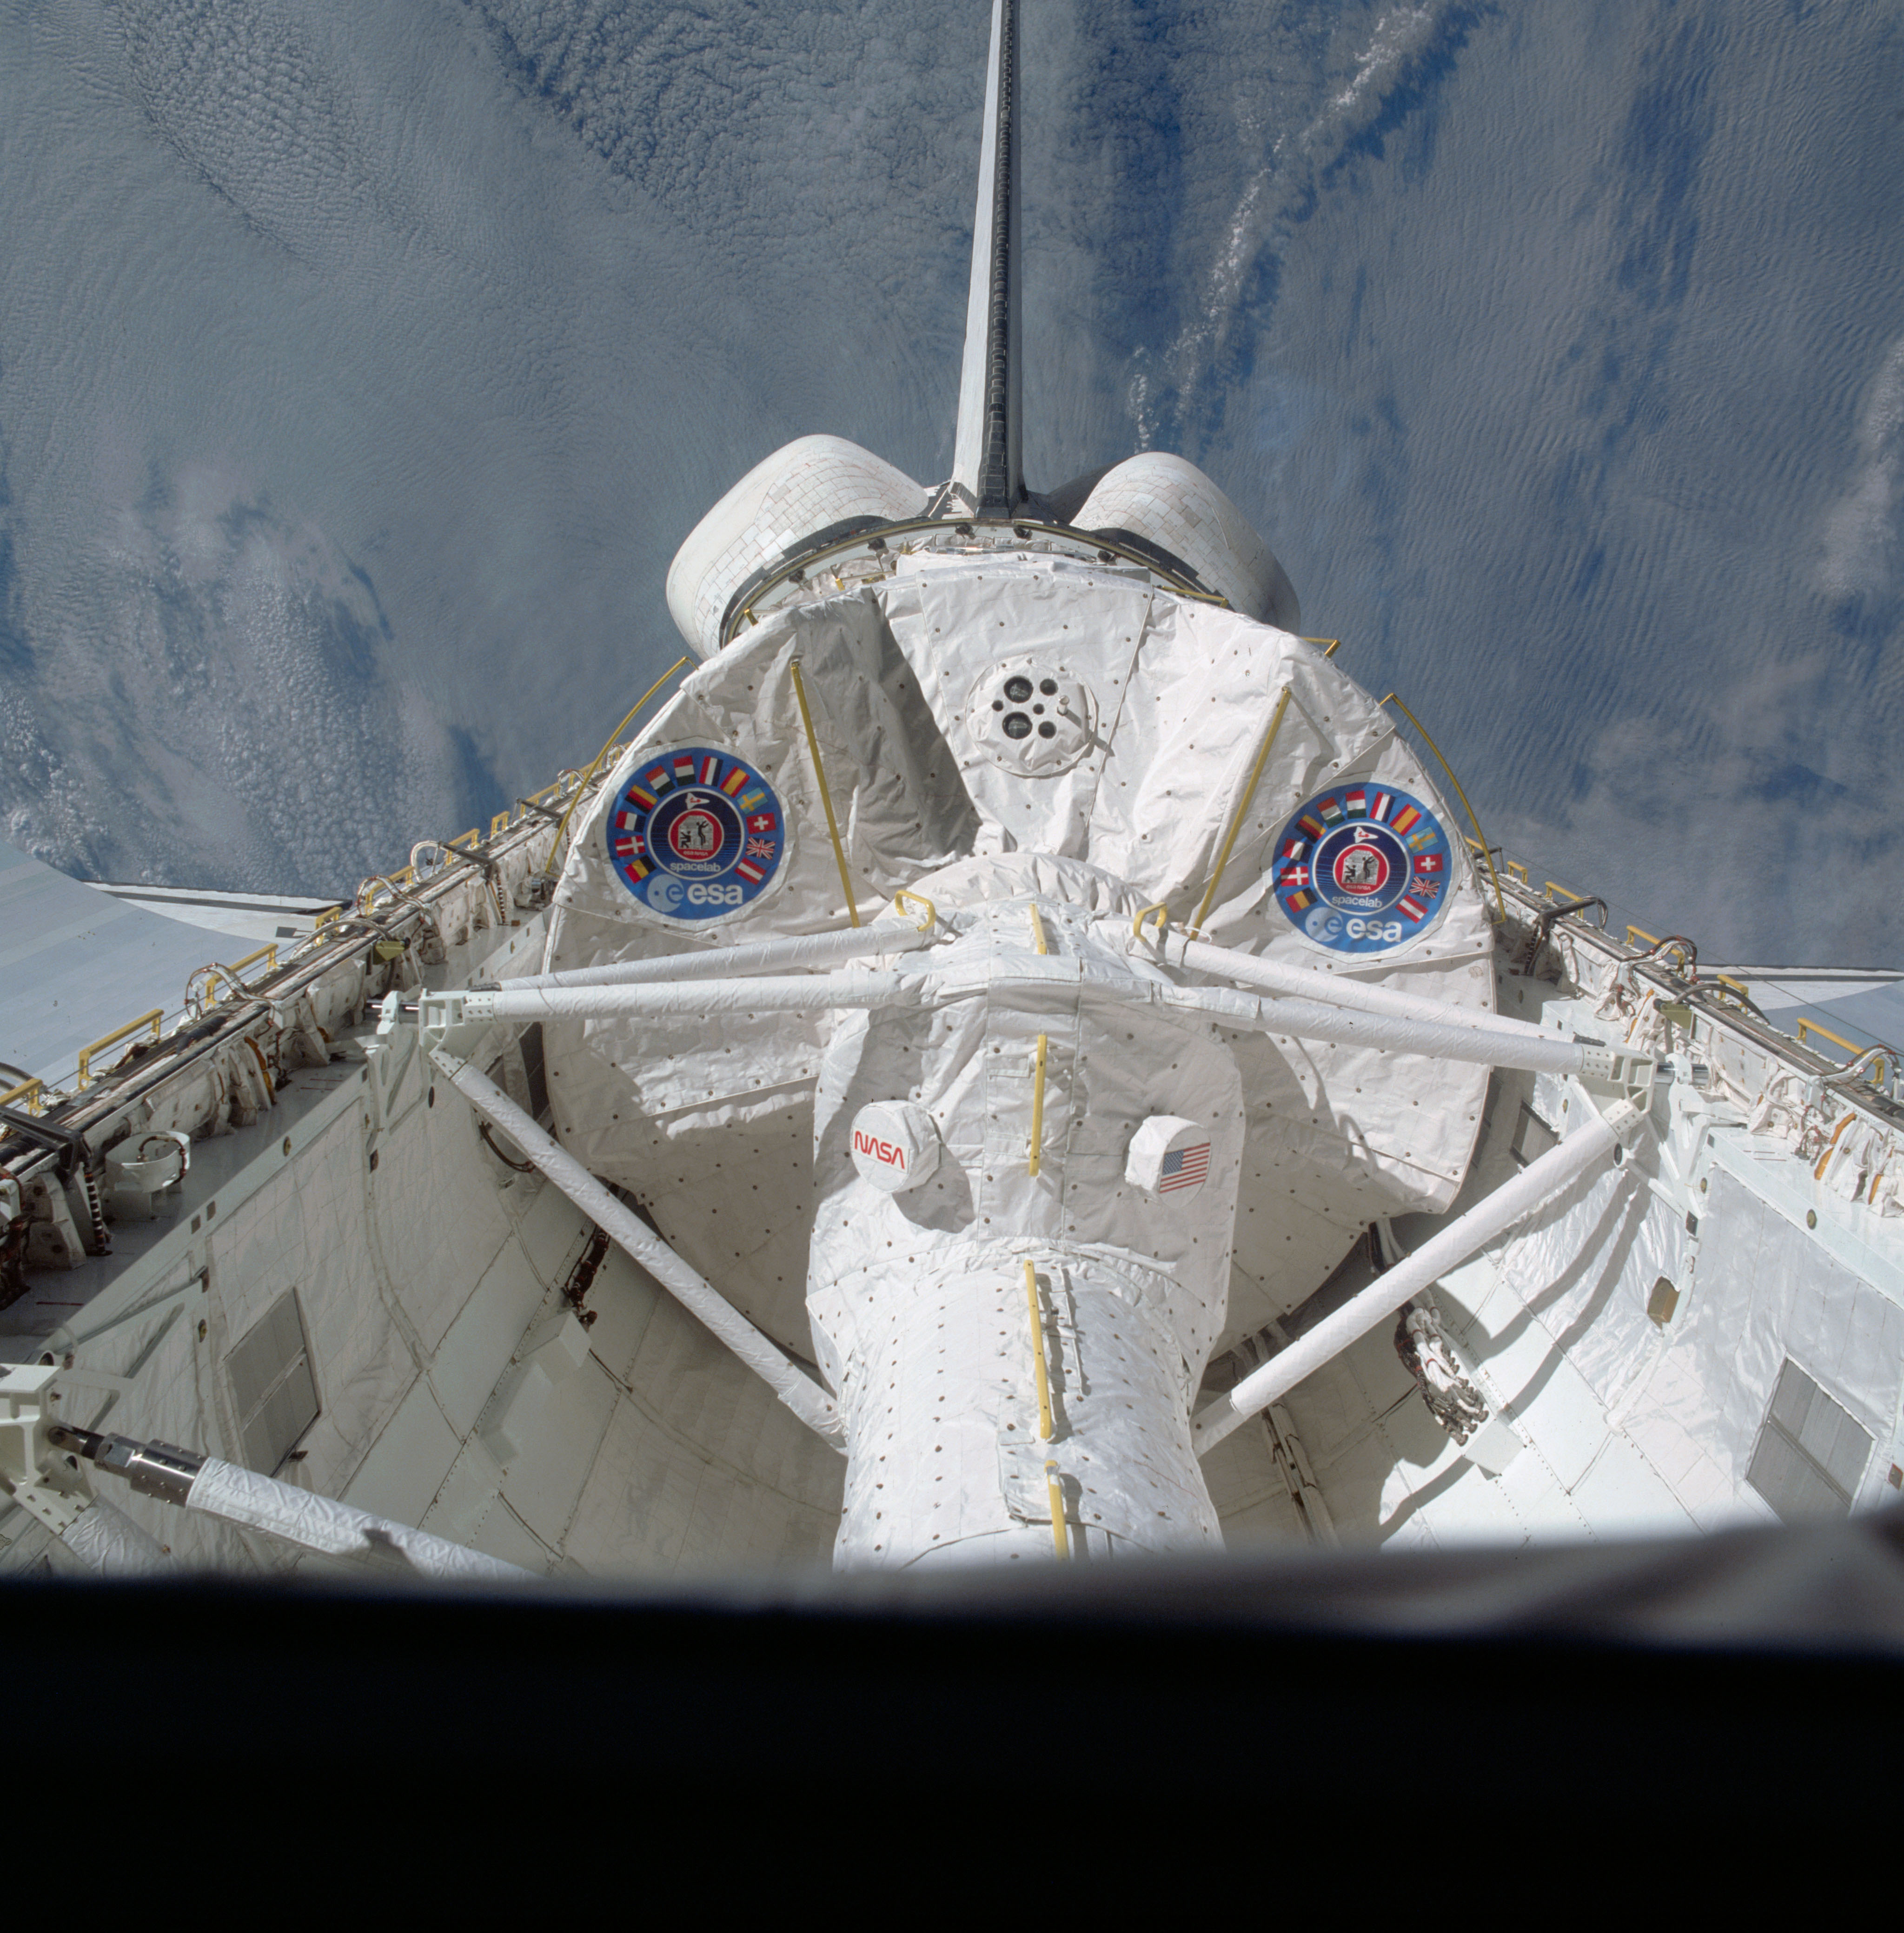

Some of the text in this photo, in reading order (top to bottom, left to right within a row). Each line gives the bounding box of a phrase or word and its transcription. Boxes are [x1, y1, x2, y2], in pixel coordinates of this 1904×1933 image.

[670, 862, 721, 872] spacelab
[687, 883, 743, 905] esa
[1332, 896, 1382, 908] spacelab
[1346, 918, 1402, 942] esa
[854, 1131, 905, 1170] NASA
